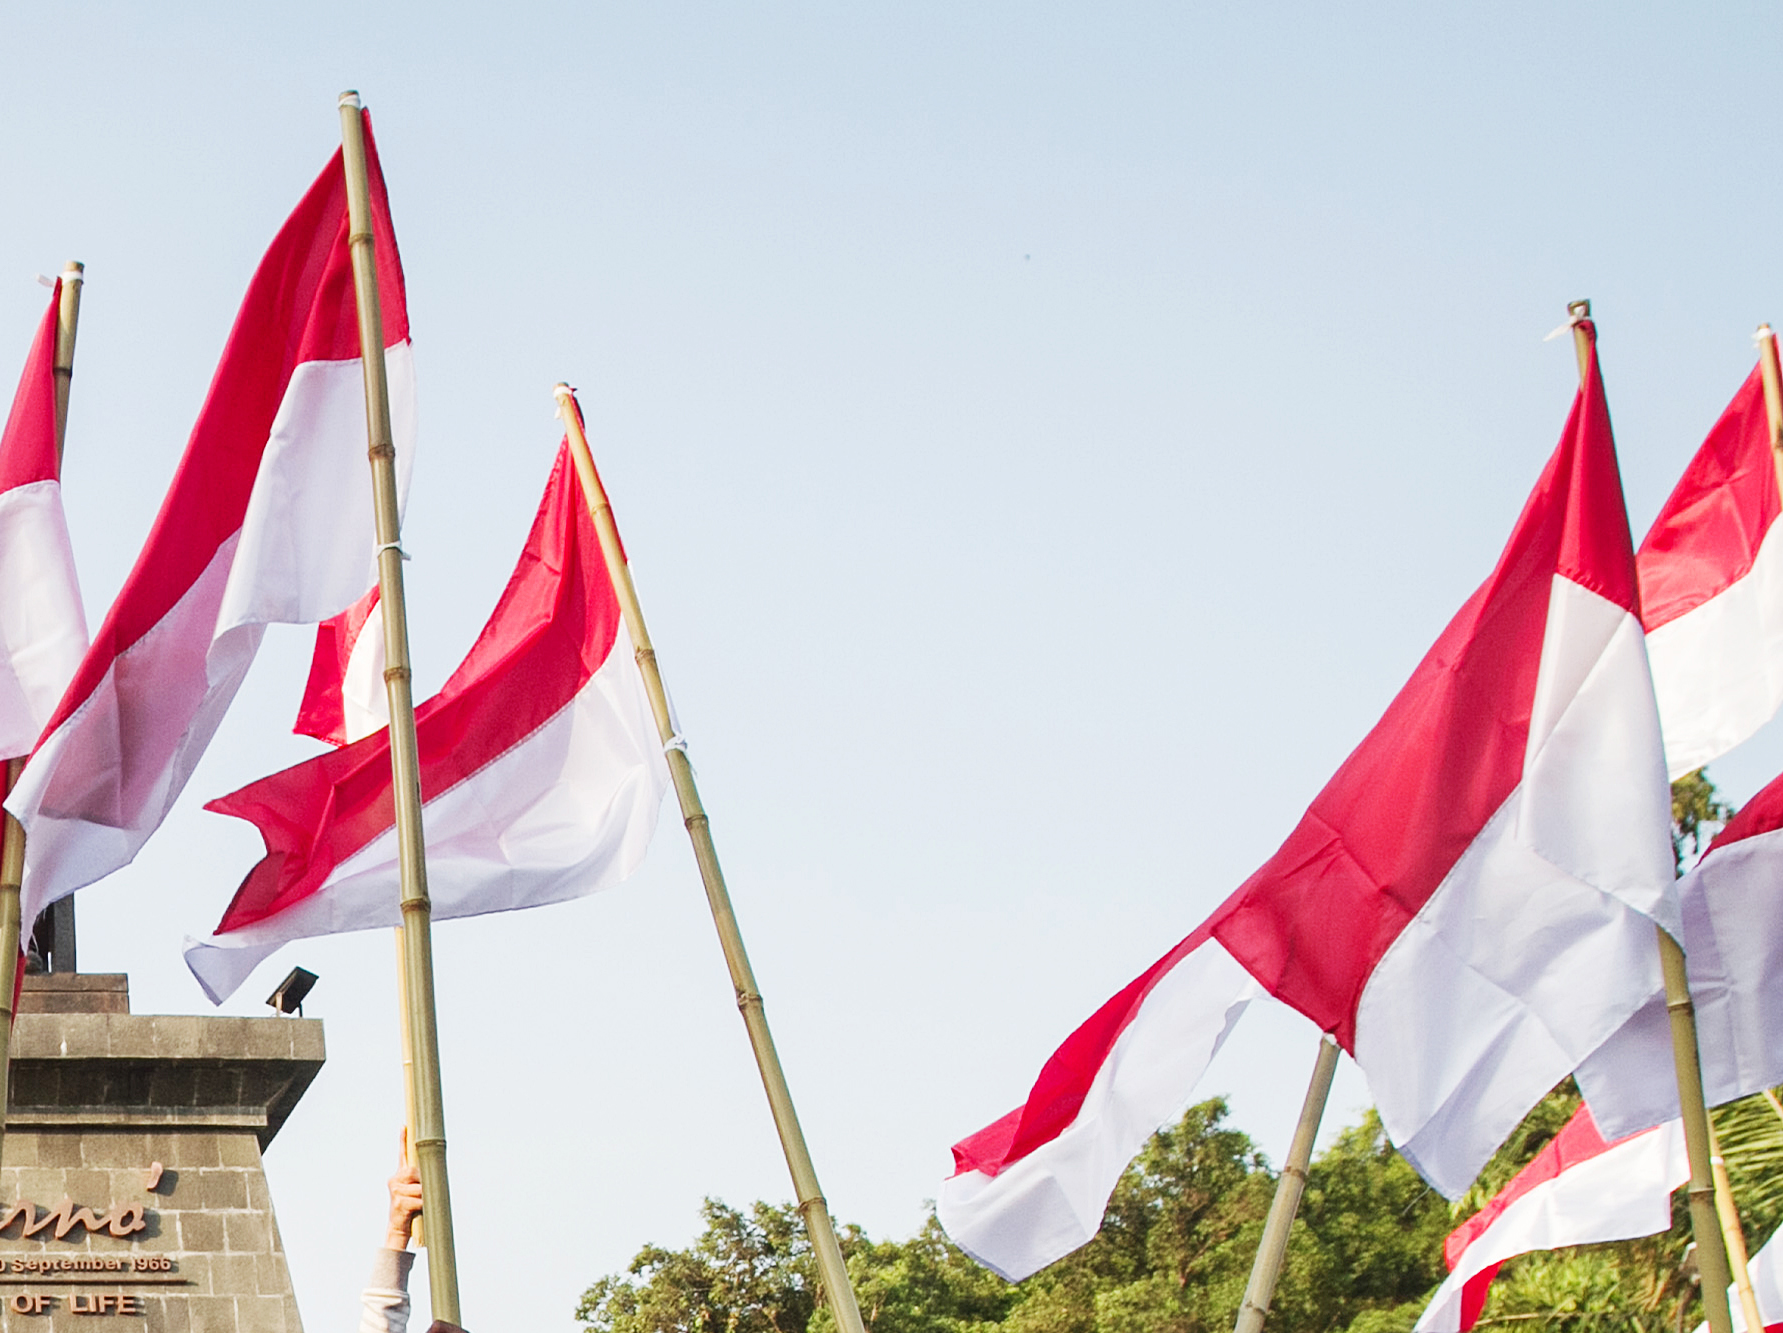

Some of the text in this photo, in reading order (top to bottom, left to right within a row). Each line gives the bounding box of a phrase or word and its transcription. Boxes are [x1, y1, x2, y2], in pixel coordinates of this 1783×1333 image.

[11, 1257, 121, 1275] September
[129, 1256, 171, 1271] 1966
[10, 1293, 51, 1314] OF
[70, 1293, 137, 1314] LIFE
